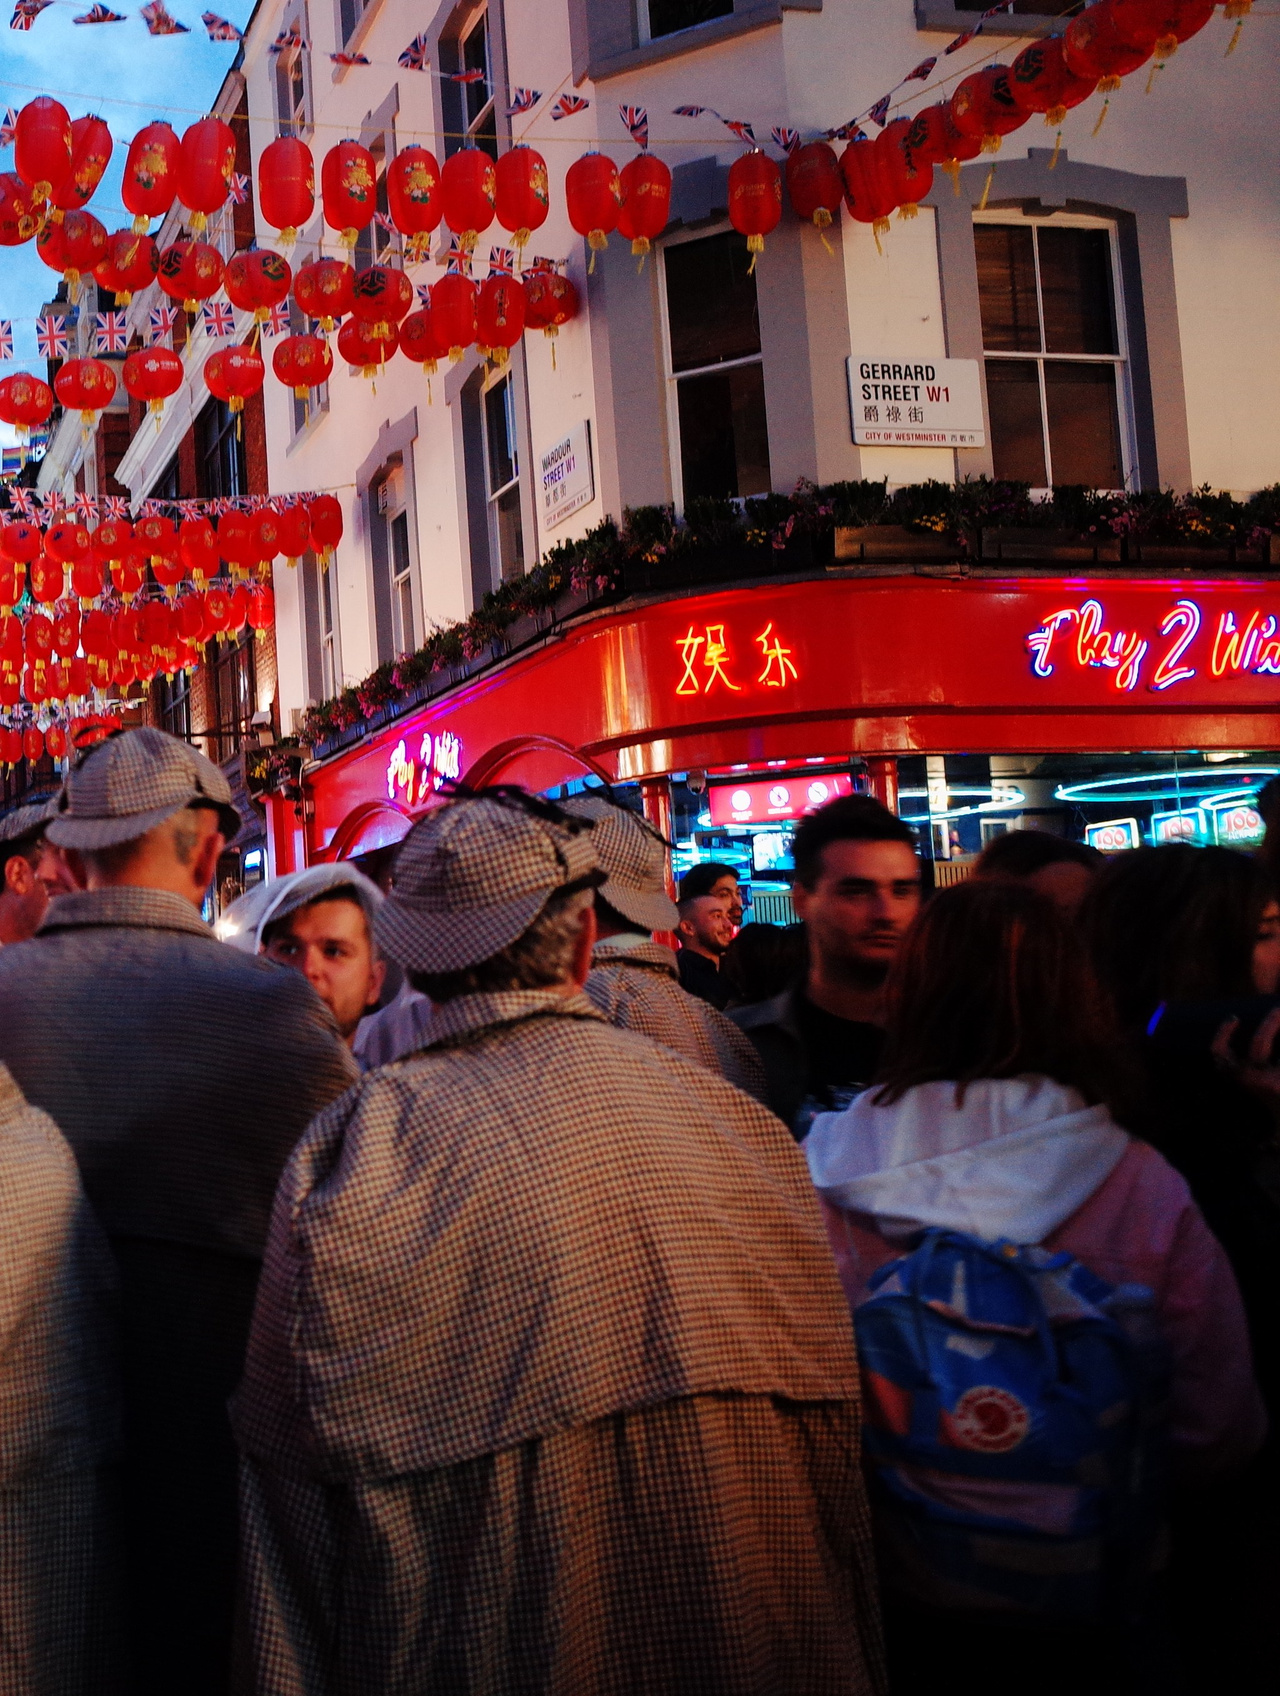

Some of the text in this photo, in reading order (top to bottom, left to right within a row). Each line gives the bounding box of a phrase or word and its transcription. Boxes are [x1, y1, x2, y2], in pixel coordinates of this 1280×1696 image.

[859, 362, 936, 382] GERRARD
[861, 383, 951, 403] STREET W1
[865, 431, 947, 443] CITY OF WESTMINSTER
[541, 438, 572, 473] WARDOUR
[543, 454, 576, 492] STREET W1
[1026, 599, 1148, 691] Play
[1153, 600, 1202, 691] 2
[1227, 811, 1260, 833] 100
